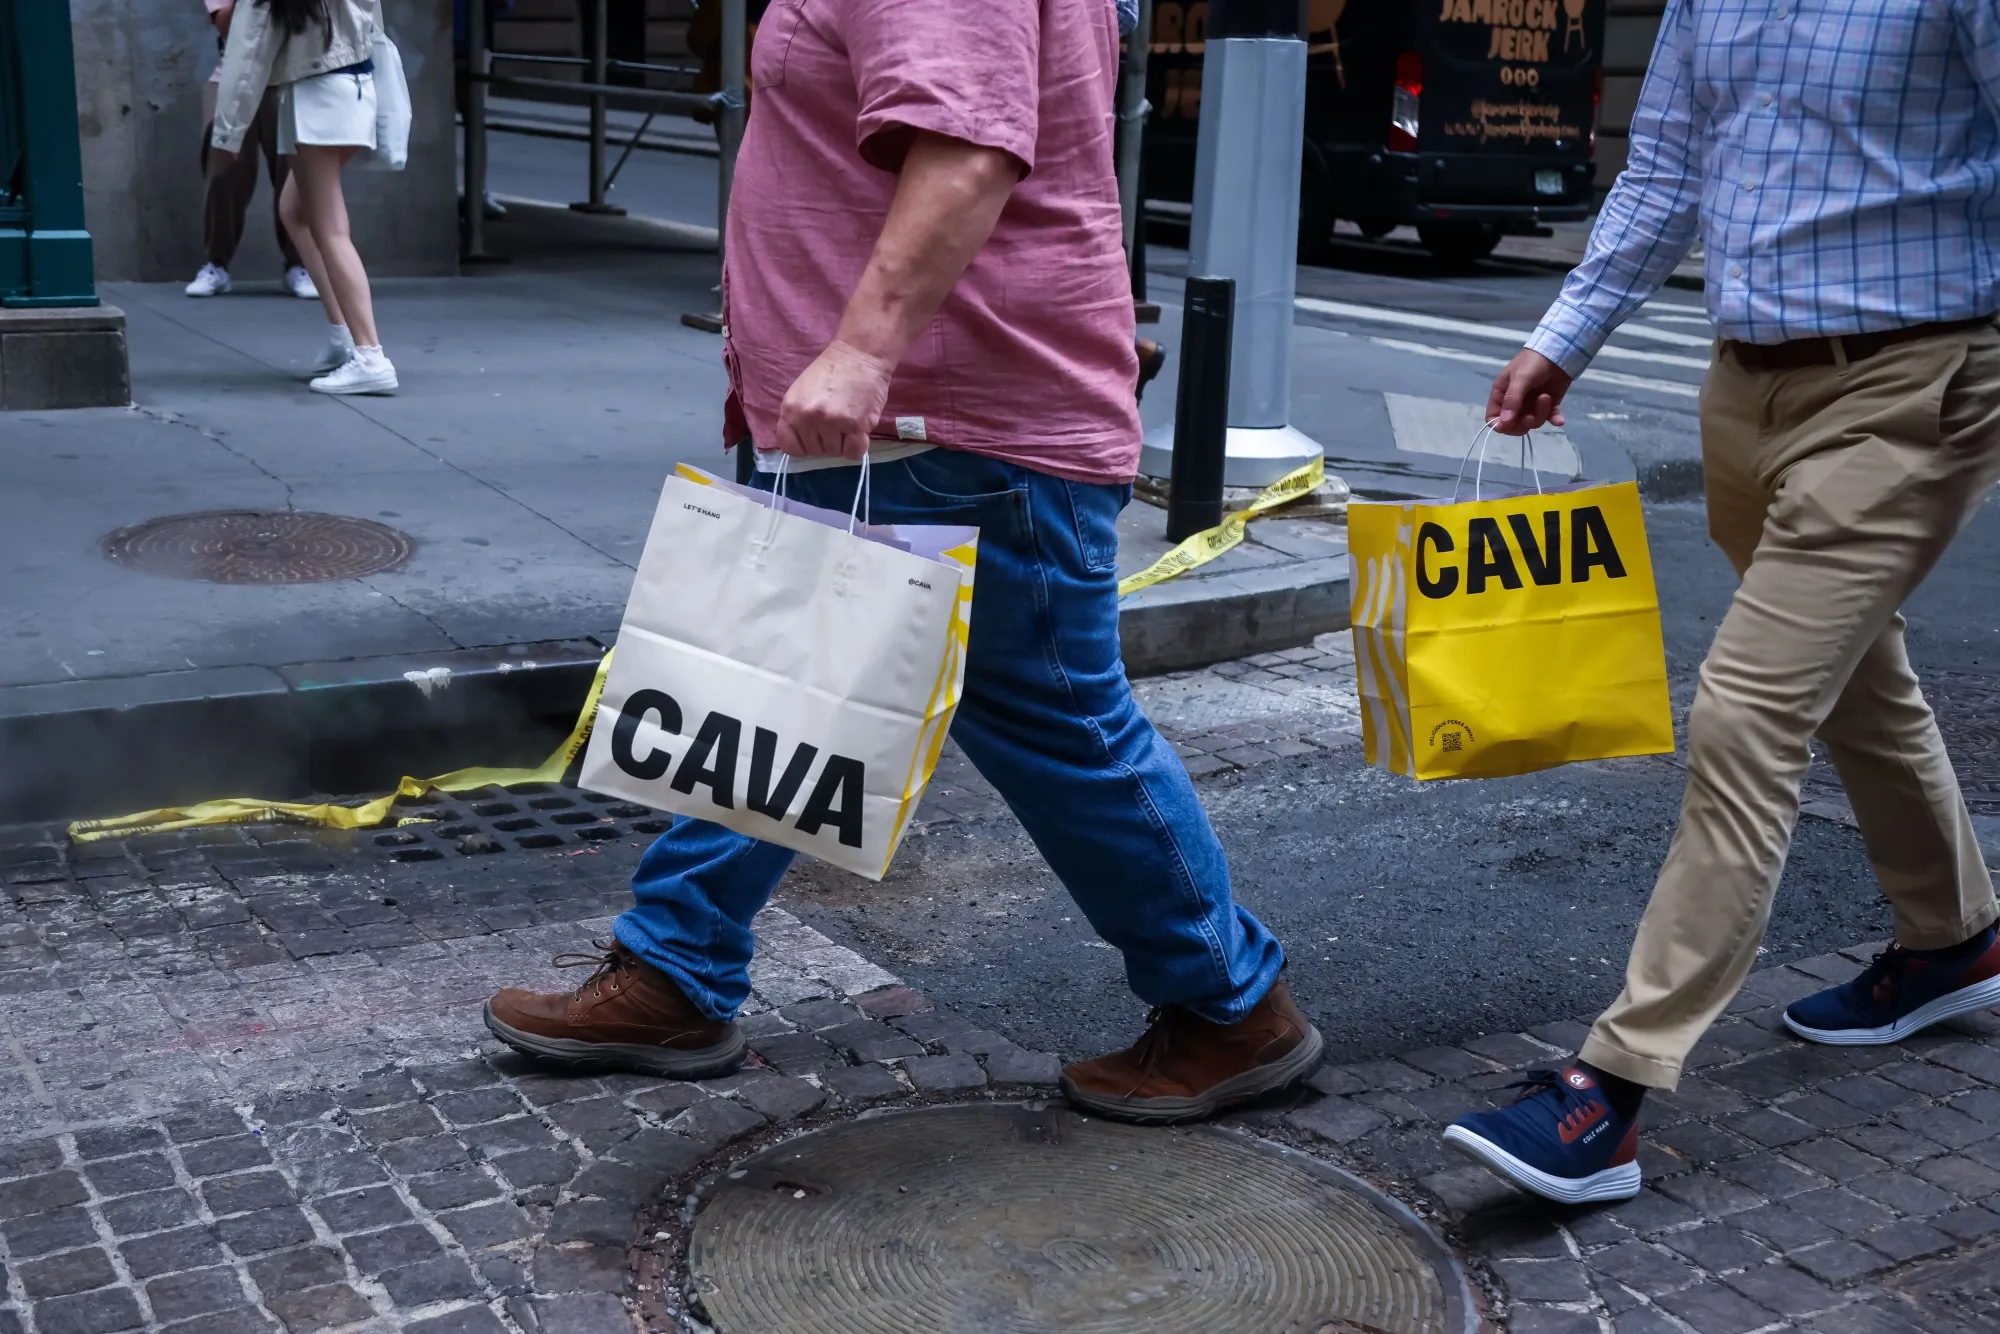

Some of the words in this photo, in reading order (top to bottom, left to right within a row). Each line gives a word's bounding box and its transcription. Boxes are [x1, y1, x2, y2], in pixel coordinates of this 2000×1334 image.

[1440, 0, 1558, 30] JAMROCK
[1487, 27, 1550, 62] JERK
[683, 502, 702, 513] LET'S
[701, 509, 721, 519] HANG
[1415, 505, 1628, 600] CAVA
[908, 577, 932, 591] @CAVA
[1429, 721, 1446, 746] DELICIOUS
[1447, 719, 1465, 727] PERKS
[611, 688, 865, 849] CAVA
[1583, 1132, 1596, 1144] COLE
